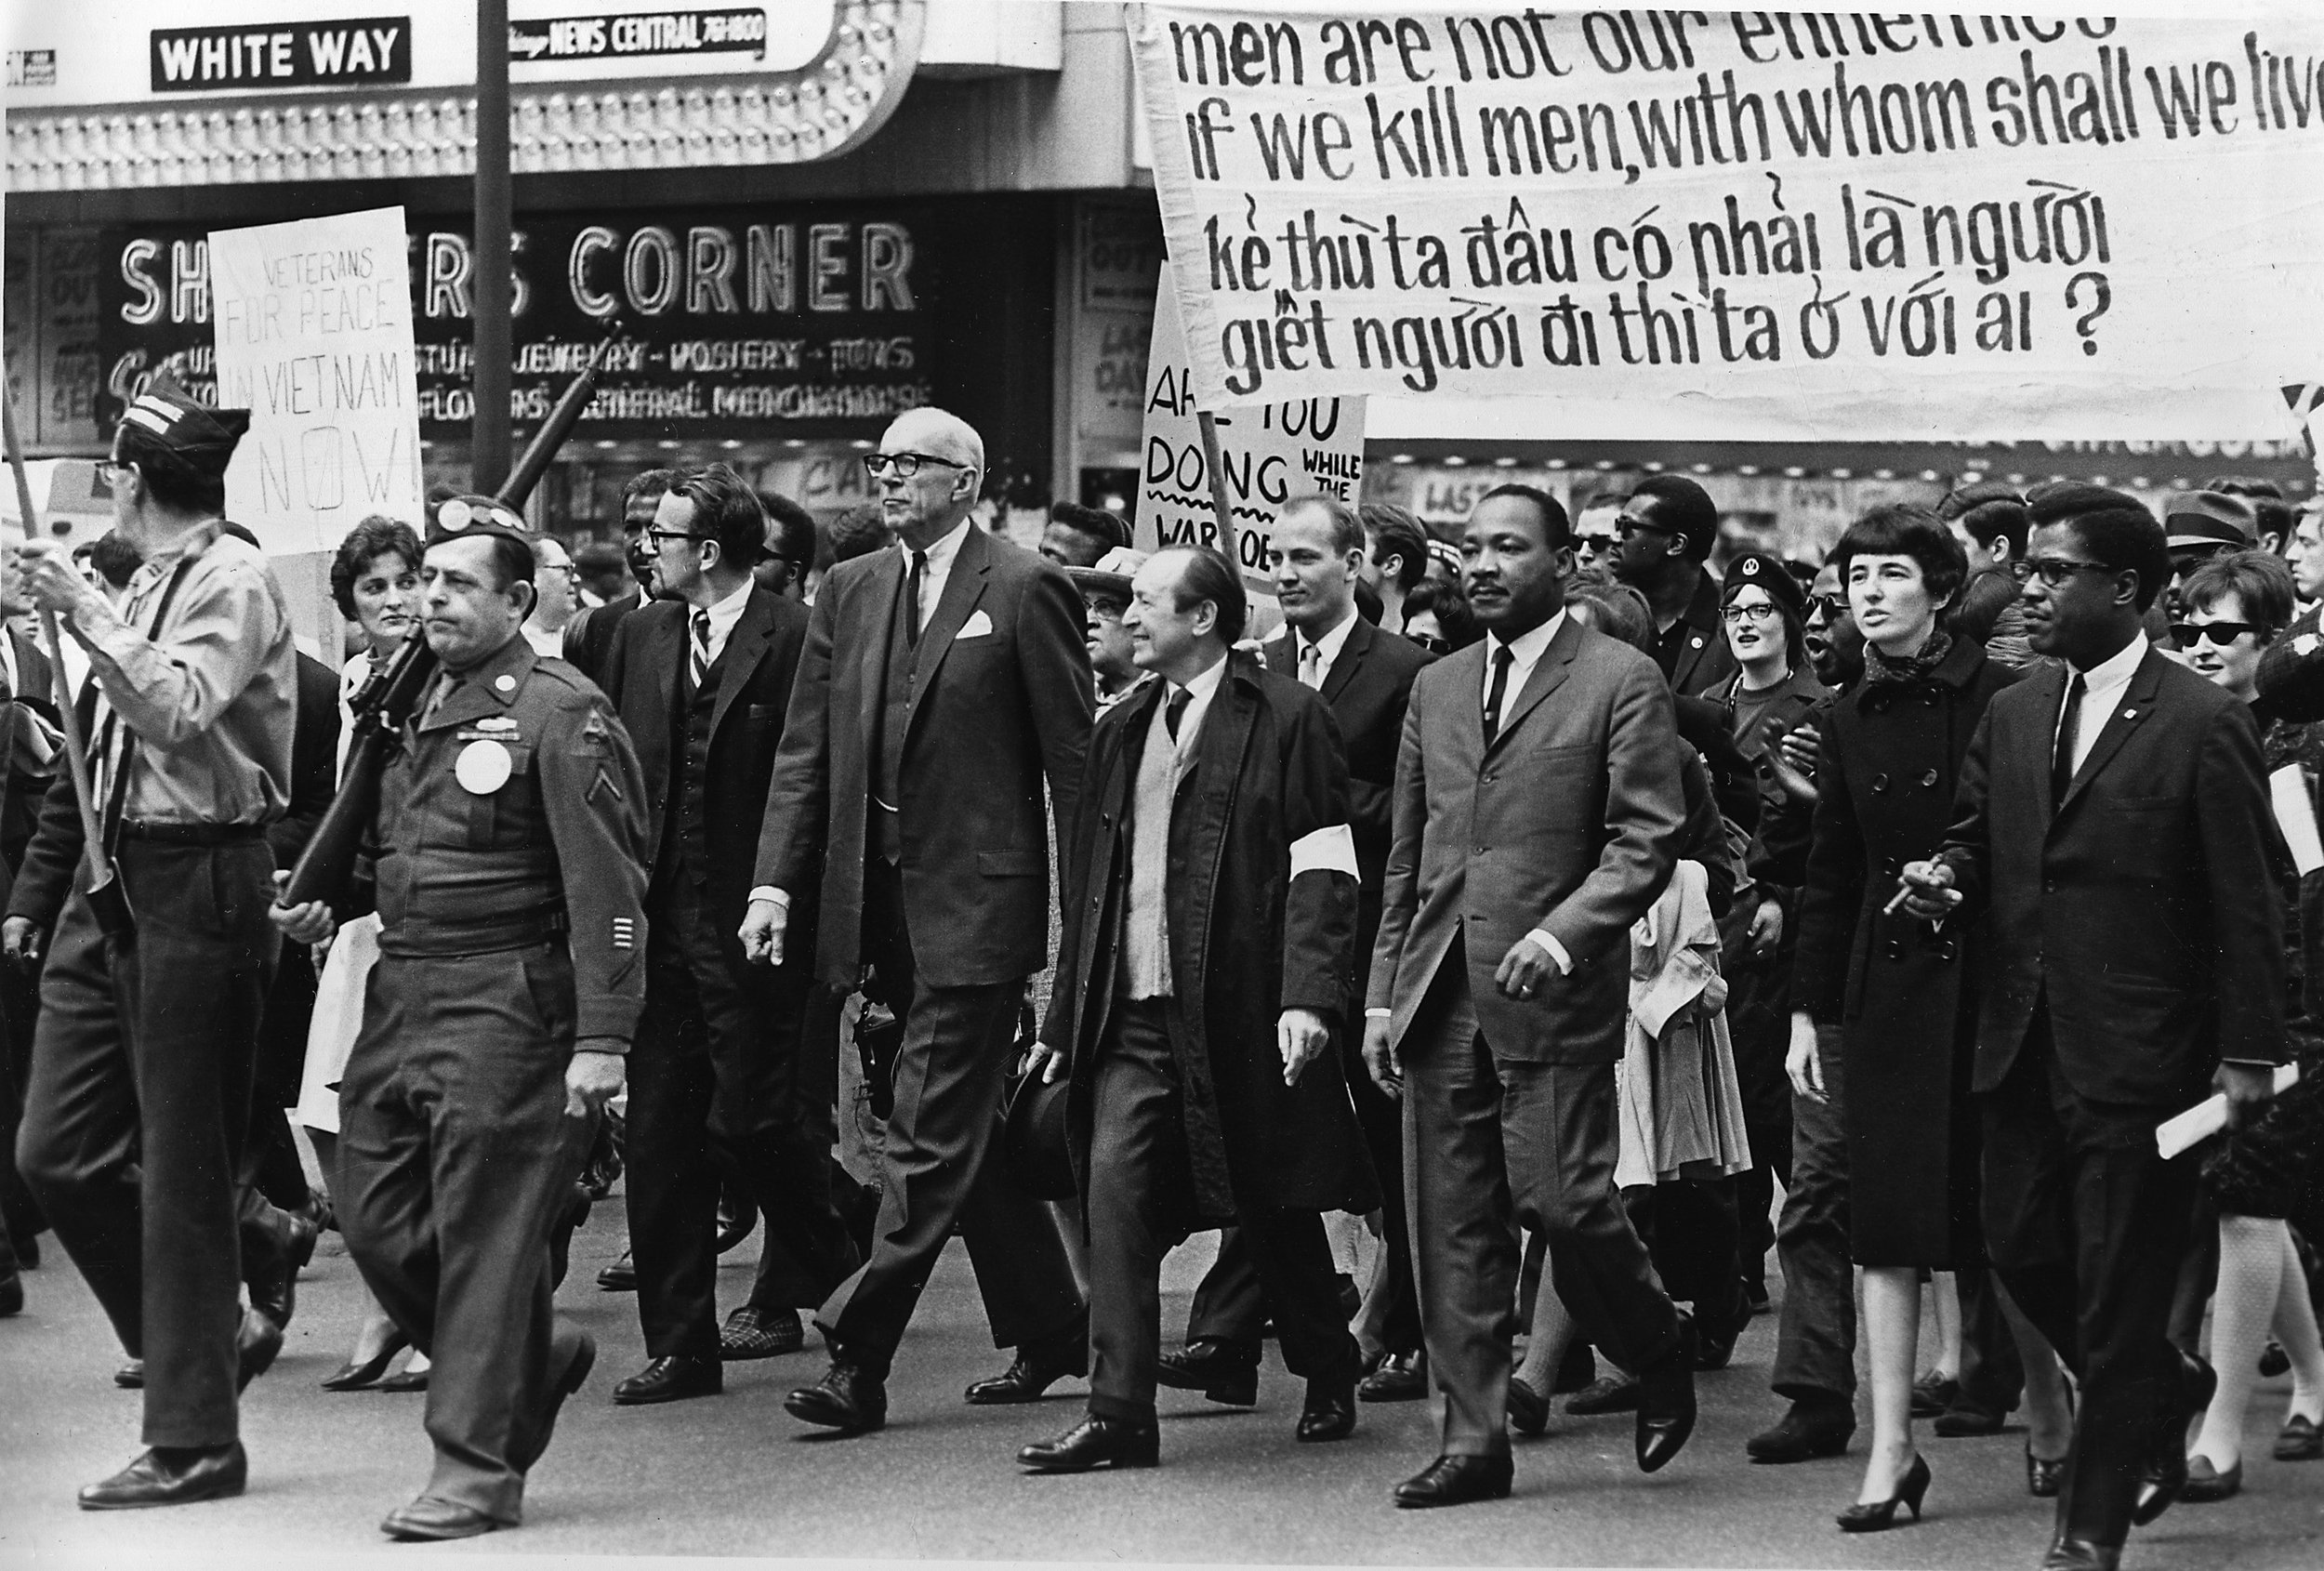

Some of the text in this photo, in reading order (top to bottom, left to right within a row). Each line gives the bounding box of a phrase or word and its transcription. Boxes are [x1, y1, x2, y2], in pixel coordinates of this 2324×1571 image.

[159, 29, 399, 82] WHITE WAY
[549, 20, 606, 55] NEWS
[612, 16, 703, 53] CENTRAL
[1169, 21, 1302, 86] men
[1320, 18, 1434, 86] are
[1445, 8, 1573, 82] not
[1582, 9, 1709, 73] our
[1185, 97, 1235, 181] if
[1250, 112, 1353, 180] we
[1365, 86, 1469, 180] kill
[1628, 71, 1771, 169] with
[1775, 60, 1978, 158] whom
[1986, 46, 2140, 146] shall
[2145, 61, 2238, 139] we
[263, 247, 373, 288] VETERANS
[1381, 214, 1450, 290] ta
[1460, 196, 1578, 288] đâu
[1594, 205, 1673, 281] có
[1842, 183, 1916, 271] là
[569, 223, 916, 316] CORNER
[227, 279, 394, 345] FOR PEACE
[1539, 293, 1600, 366] đi
[1710, 287, 1780, 362] ta
[1861, 271, 1956, 357] với
[1975, 291, 2032, 351] ai
[2065, 271, 2111, 356] ?
[228, 363, 253, 409] IN
[264, 351, 401, 415] VIETNAM
[1147, 435, 1288, 505] DONG
[1302, 448, 1361, 480] WHILE
[1314, 476, 1351, 502] THE
[1156, 514, 1218, 548] WAR
